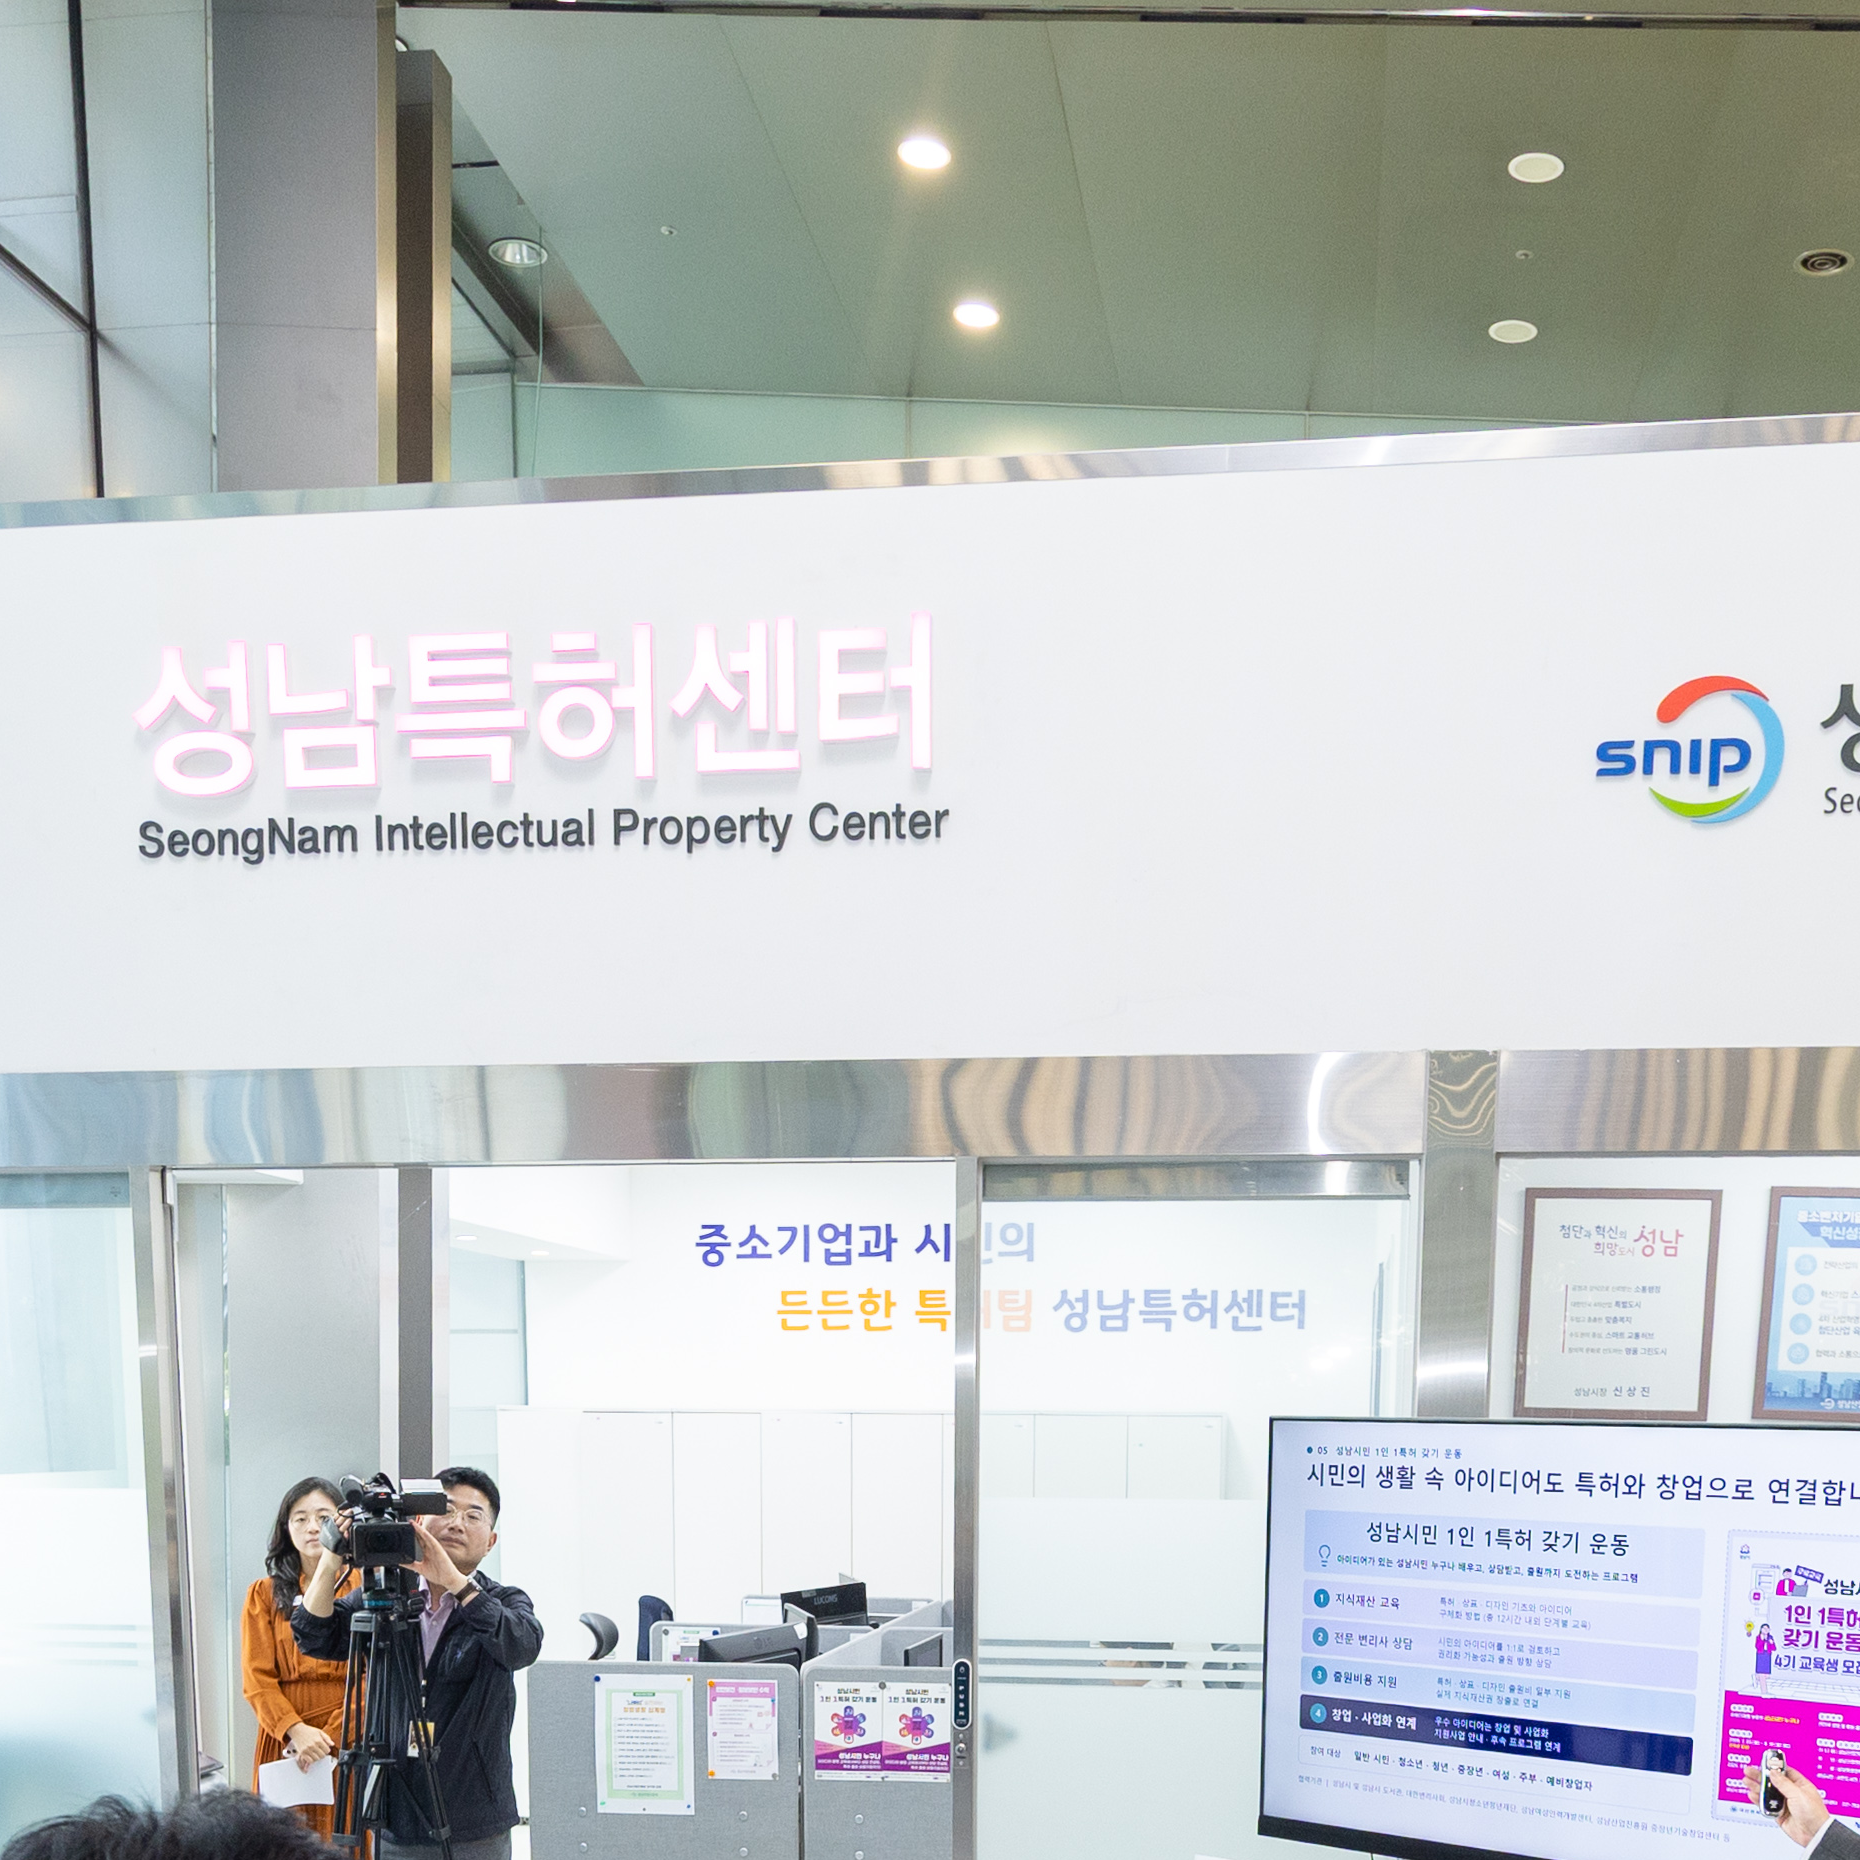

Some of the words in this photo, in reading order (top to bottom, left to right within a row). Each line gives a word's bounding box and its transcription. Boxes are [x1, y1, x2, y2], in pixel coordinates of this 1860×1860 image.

[133, 611, 933, 797] 성남특허센터
[1595, 737, 1751, 786] snip
[139, 816, 358, 864] SeongNam
[374, 808, 595, 853] Intellectual
[612, 802, 791, 853] Property
[808, 801, 949, 842] Center
[1559, 1224, 1592, 1239] 첨단과
[1595, 1224, 1627, 1239] 혁신의
[1633, 1226, 1684, 1257] 성남
[695, 1223, 898, 1267] 중소기업과
[1594, 1241, 1635, 1256] 희망도시
[777, 1288, 897, 1332] 든든한
[915, 1287, 1033, 1333] 특팀
[1053, 1289, 1307, 1333] 성남특허센터
[1574, 1388, 1607, 1397] 성남시장
[1317, 1446, 1328, 1455] 05
[1336, 1446, 1370, 1457] 성남시민
[1376, 1447, 1389, 1458] 1인
[1394, 1447, 1417, 1458] 1특허
[1422, 1448, 1439, 1459] 갖기
[1444, 1448, 1462, 1459] 운동
[1307, 1463, 1366, 1489] 시민의
[1376, 1465, 1416, 1490] 생활
[1425, 1466, 1444, 1491] 속
[1455, 1468, 1564, 1495] 아이디어도
[1575, 1471, 1646, 1500] 특허와
[1656, 1473, 1755, 1501] 창업으로
[1367, 1521, 1438, 1546] 성남시민
[1447, 1526, 1474, 1548] 1인
[1485, 1528, 1532, 1552] 1특허
[1542, 1531, 1579, 1554] 갖기
[1589, 1532, 1630, 1557] 운동
[1337, 1554, 1375, 1567] 아이디어가
[1378, 1556, 1393, 1568] 있는
[1396, 1557, 1428, 1570] 성남시민
[1431, 1560, 1455, 1572] 누구나
[1458, 1561, 1485, 1574] 배우고,
[1487, 1563, 1524, 1577] 상담받고,
[1527, 1566, 1561, 1579] 출원까지
[1564, 1570, 1599, 1583] 도전하는
[1602, 1571, 1638, 1584] 프로그램
[1335, 1593, 1376, 1609] 지식재산
[1380, 1596, 1400, 1609] 교육
[1785, 1605, 1811, 1624] 1인
[1334, 1631, 1354, 1646] 전문
[1358, 1633, 1388, 1649] 변리사
[1392, 1636, 1413, 1651] 상담
[1784, 1628, 1819, 1648] 갖기
[1775, 1654, 1795, 1669] 4기
[1800, 1656, 1839, 1673] 교육생
[1333, 1671, 1373, 1687] 출원비용
[1377, 1674, 1397, 1689] 지원
[1332, 1708, 1352, 1724] 창업
[1362, 1711, 1392, 1728] 사업화
[1396, 1715, 1417, 1730] 연계
[1524, 1726, 1549, 1739] 사업화
[1355, 1750, 1370, 1763] 일반
[1373, 1754, 1390, 1766] 시민
[1399, 1756, 1423, 1770] 청소년
[1432, 1760, 1448, 1773] 청년
[1457, 1763, 1483, 1778] 중장년
[1493, 1768, 1509, 1781] 여성
[1519, 1771, 1537, 1784] 주부
[1547, 1774, 1593, 1792] 예비창업자
